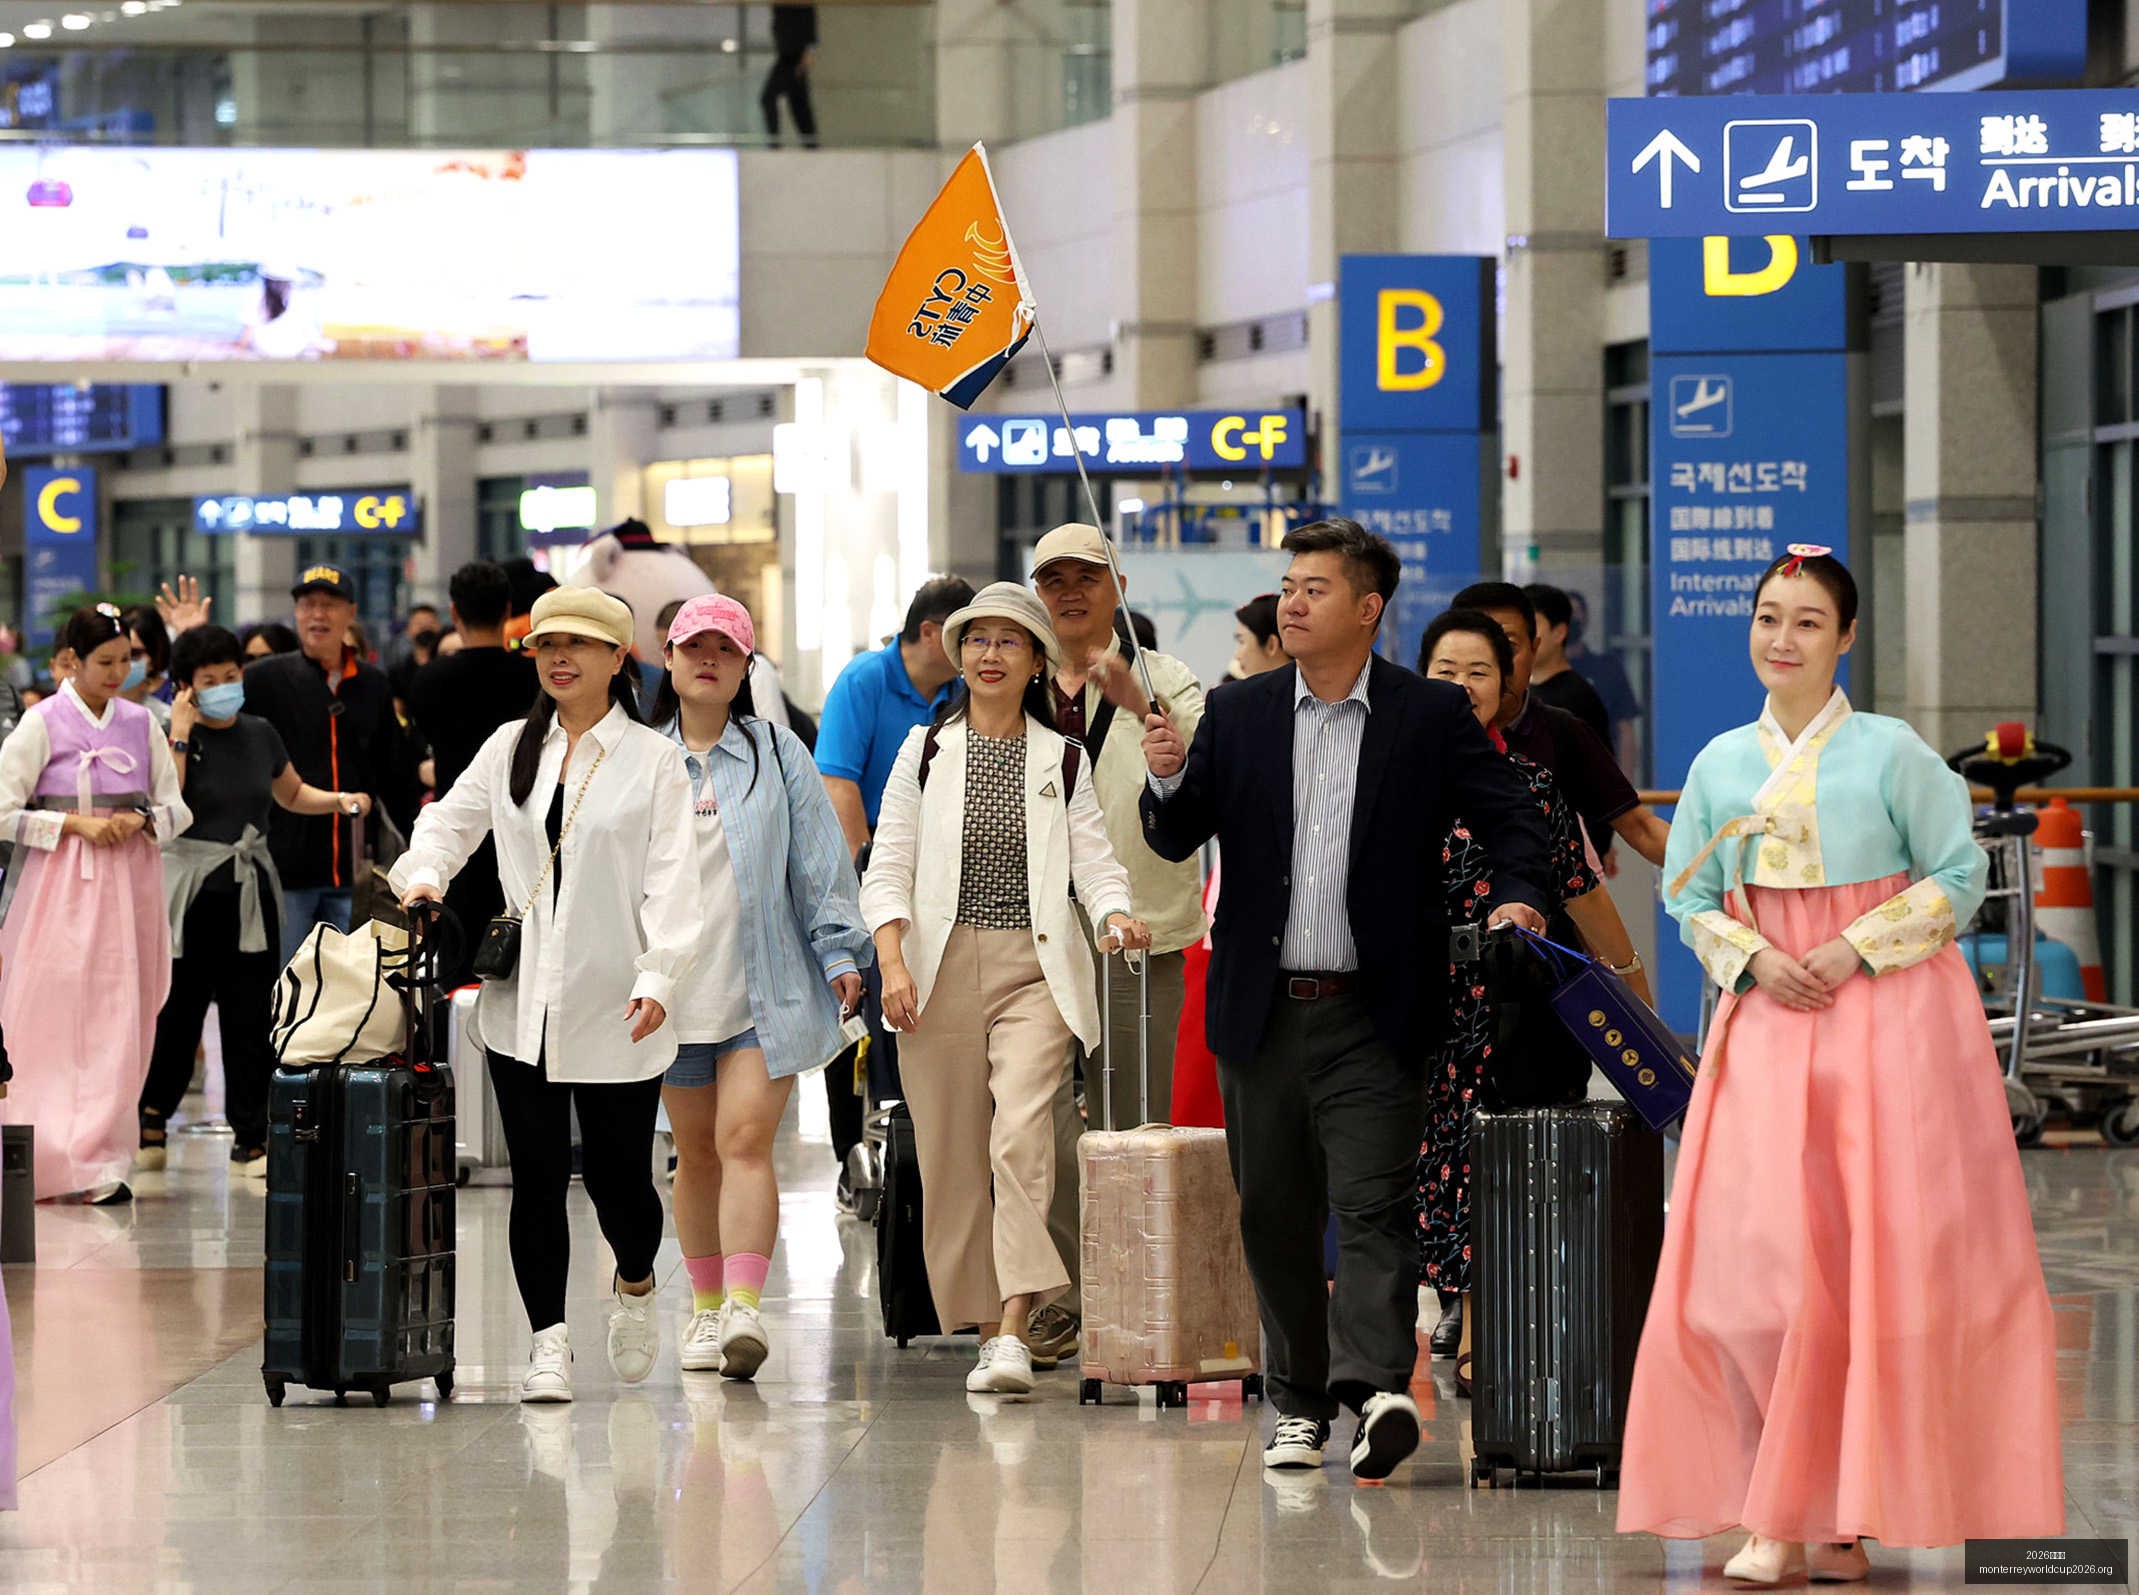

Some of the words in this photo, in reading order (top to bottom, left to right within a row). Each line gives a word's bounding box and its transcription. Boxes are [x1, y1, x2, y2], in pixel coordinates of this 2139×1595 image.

[1846, 135, 1950, 192] 도착
[1980, 163, 2139, 209] Arrival
[1377, 289, 1446, 392] B
[1211, 415, 1288, 462] C-F
[1670, 461, 1808, 493] 국제선도착
[37, 477, 82, 534] C
[1670, 572, 1764, 592] Internat
